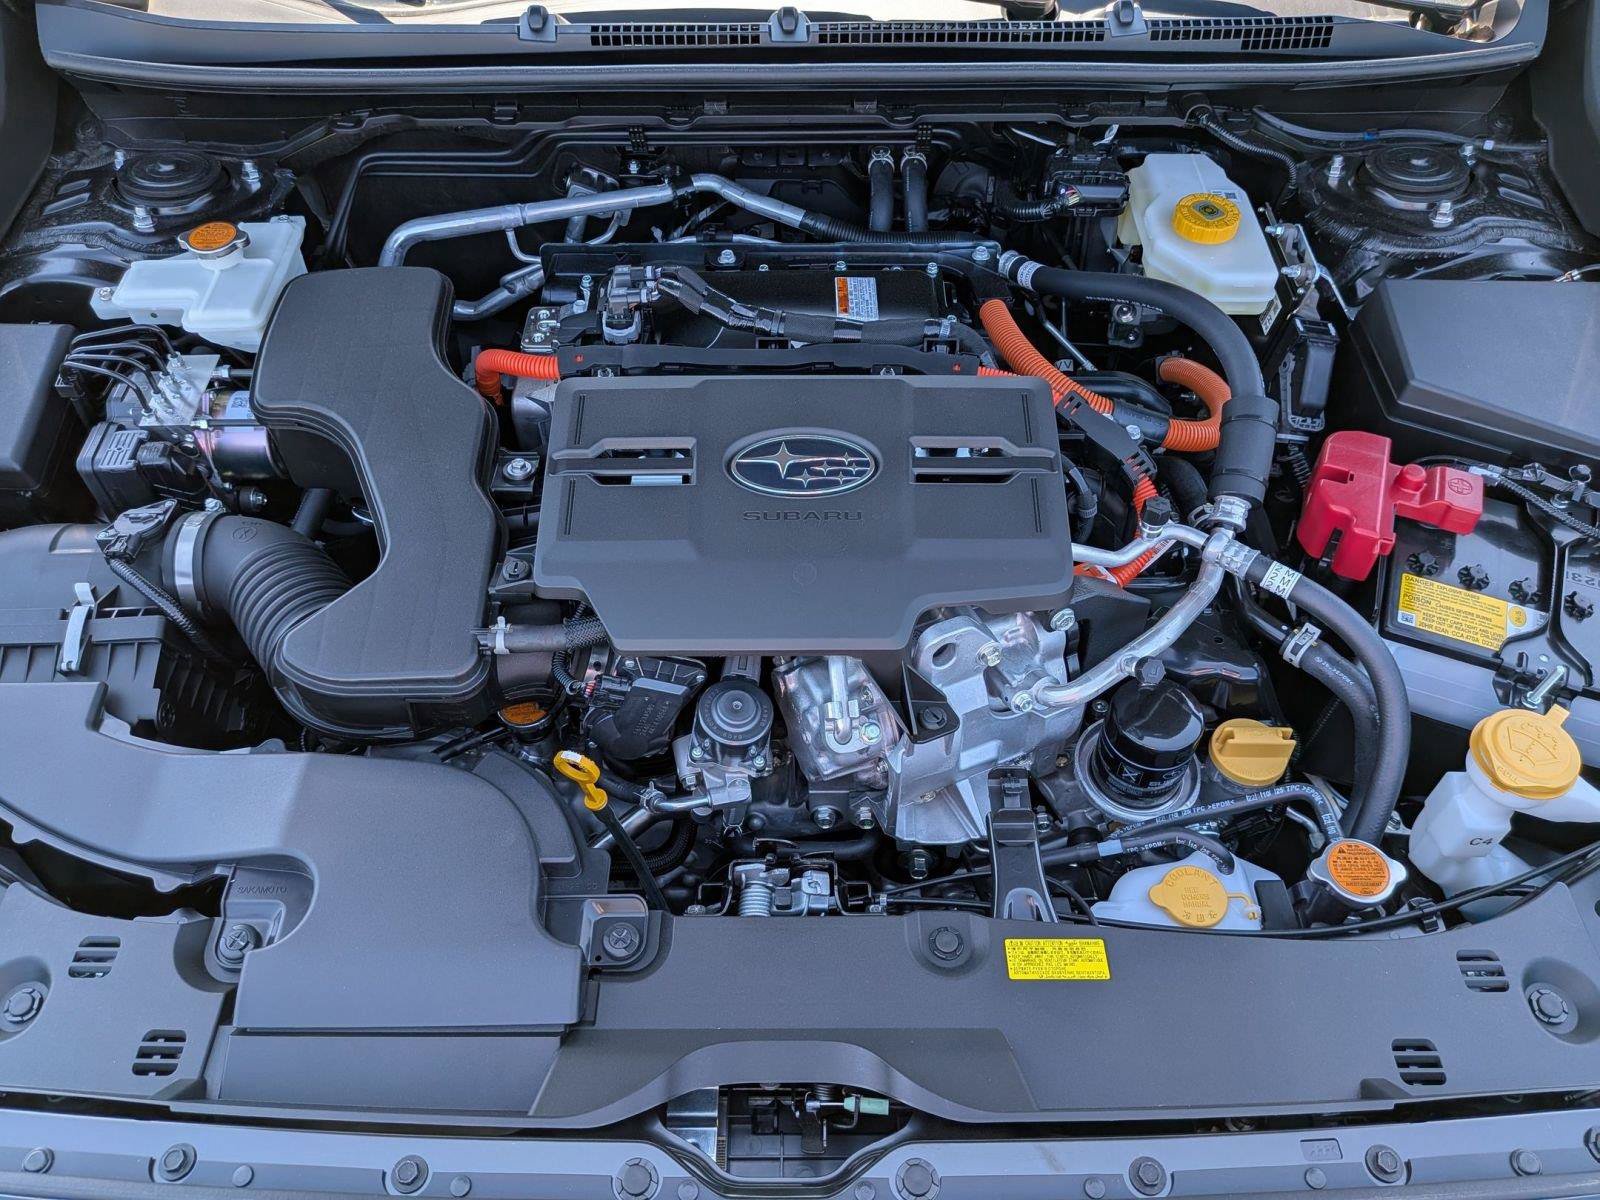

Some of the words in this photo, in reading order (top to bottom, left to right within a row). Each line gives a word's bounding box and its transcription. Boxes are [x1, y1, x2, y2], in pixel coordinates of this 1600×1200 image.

[743, 511, 862, 521] SUBARU
[1284, 568, 1296, 578] M
[1280, 576, 1291, 586] M
[1404, 575, 1434, 587] DANGER
[1266, 580, 1274, 588] 2
[1276, 586, 1286, 595] M
[1402, 593, 1431, 605] POISON
[1285, 783, 1300, 792] TPC
[1469, 837, 1494, 846] C4
[238, 886, 288, 894] SAKAMOTO
